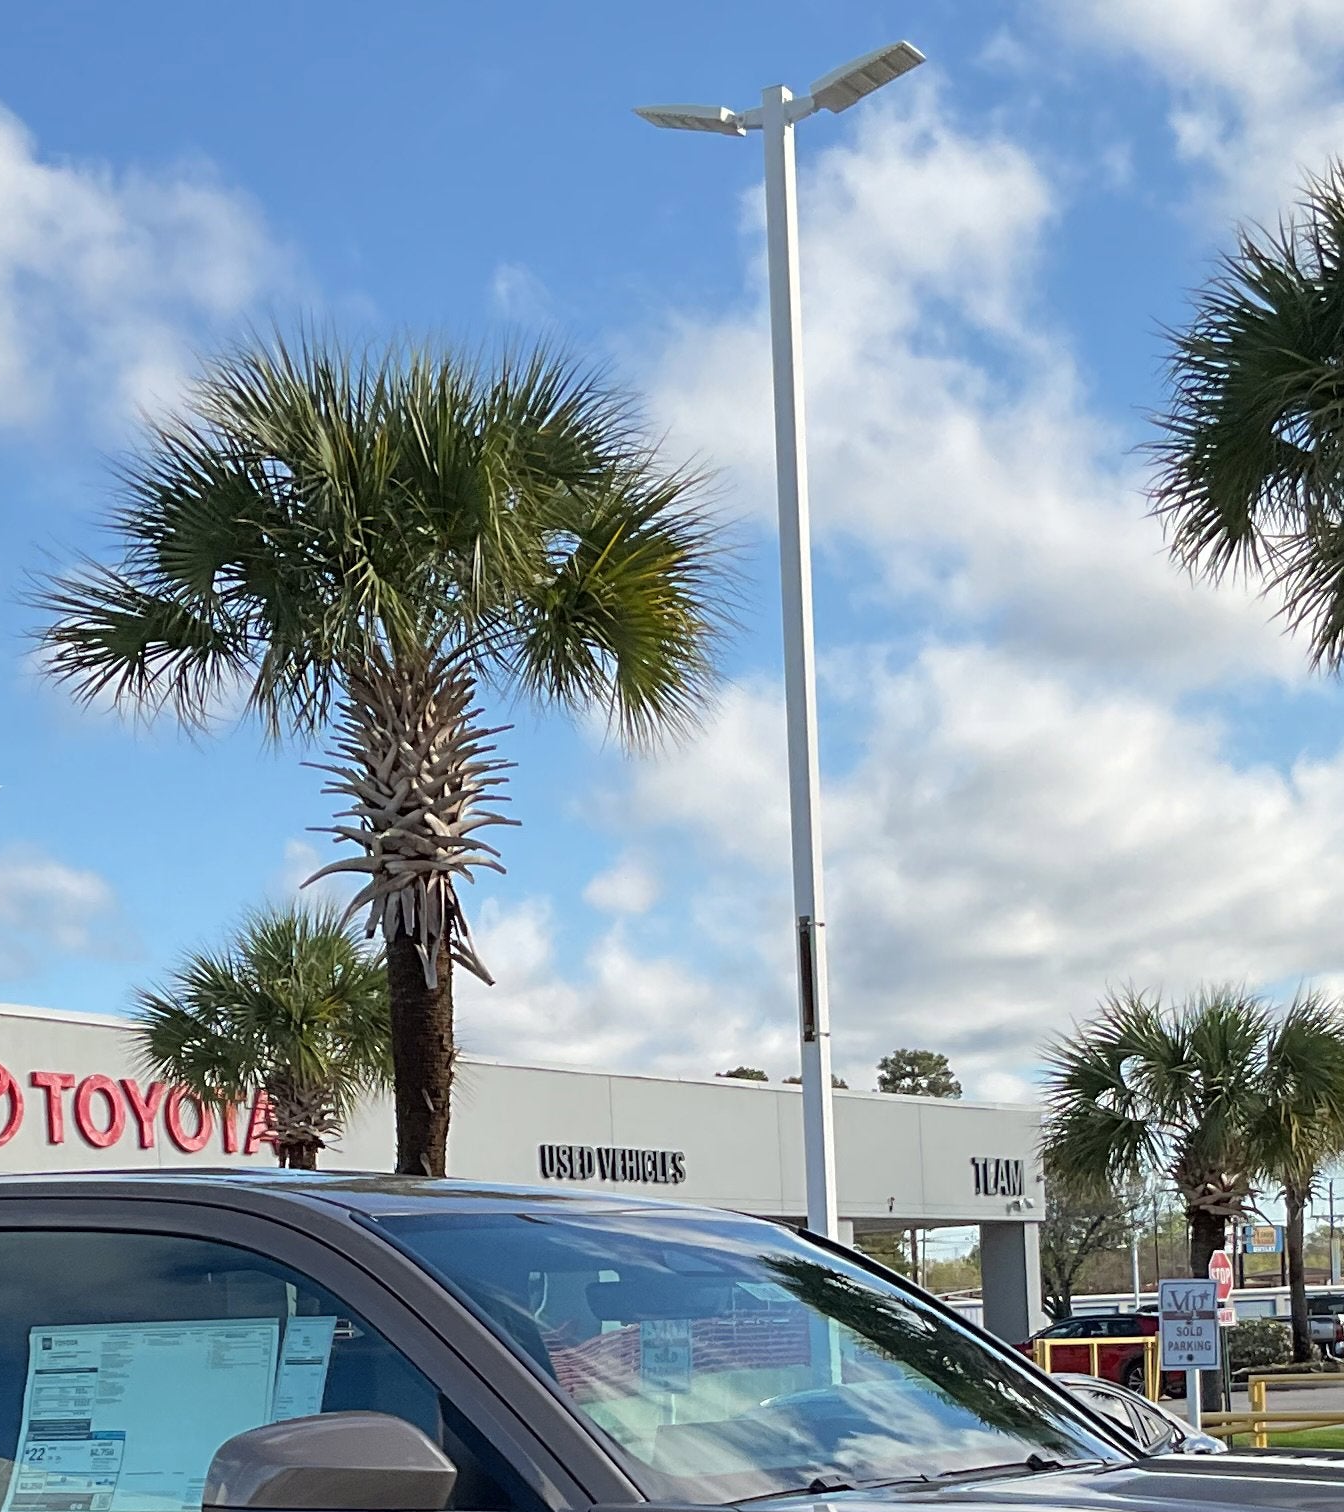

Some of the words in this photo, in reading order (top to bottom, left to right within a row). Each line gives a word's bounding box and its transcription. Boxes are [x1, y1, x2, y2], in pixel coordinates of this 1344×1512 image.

[30, 1072, 280, 1154] TOYOTA
[539, 1144, 595, 1179] USED
[596, 1147, 686, 1184] VEHICLES
[970, 1157, 1024, 1196] TEAM
[1211, 1267, 1232, 1284] STOP
[1176, 1326, 1203, 1337] SOLD
[1167, 1341, 1212, 1351] PARKING
[28, 1447, 45, 1461] 22
